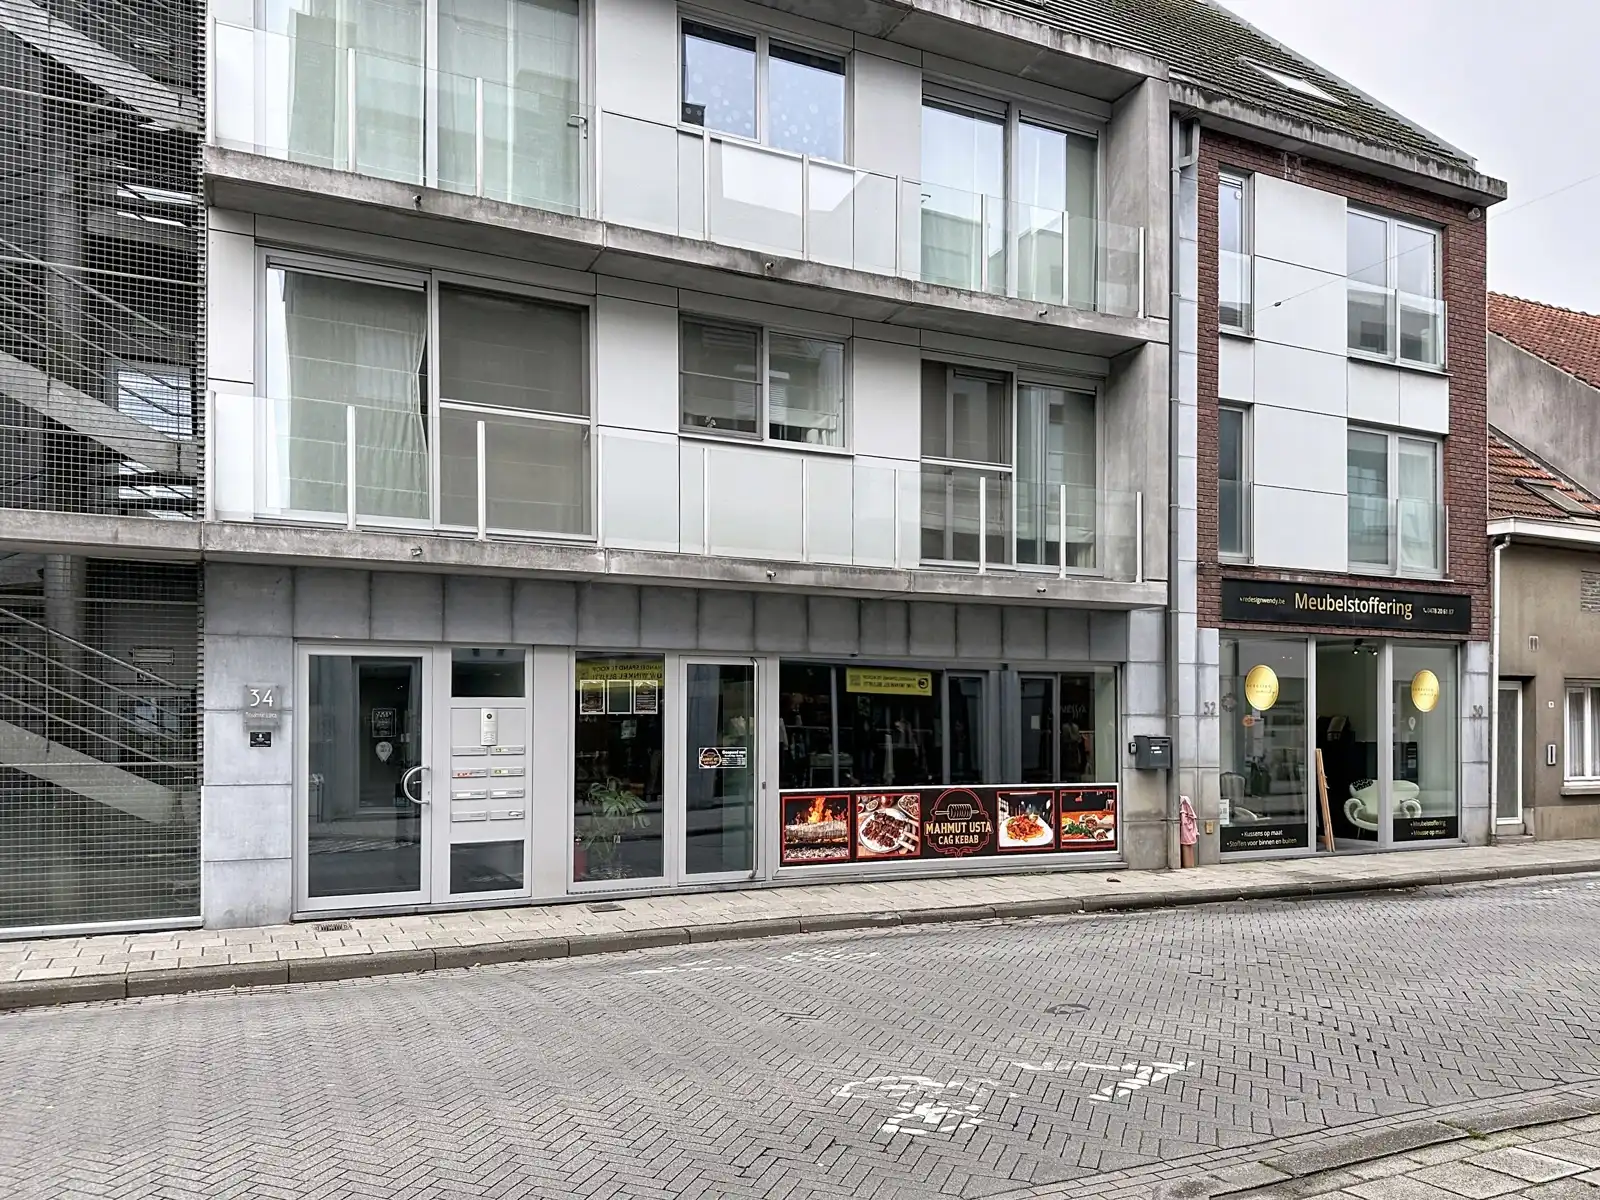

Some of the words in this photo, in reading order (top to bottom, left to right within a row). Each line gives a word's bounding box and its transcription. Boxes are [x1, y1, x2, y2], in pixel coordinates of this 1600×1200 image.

[1294, 592, 1413, 620] Meubelstoffering
[250, 689, 273, 707] 34
[926, 822, 967, 835] MAHMUT
[969, 821, 992, 833] USTA
[955, 834, 979, 844] KEBAB
